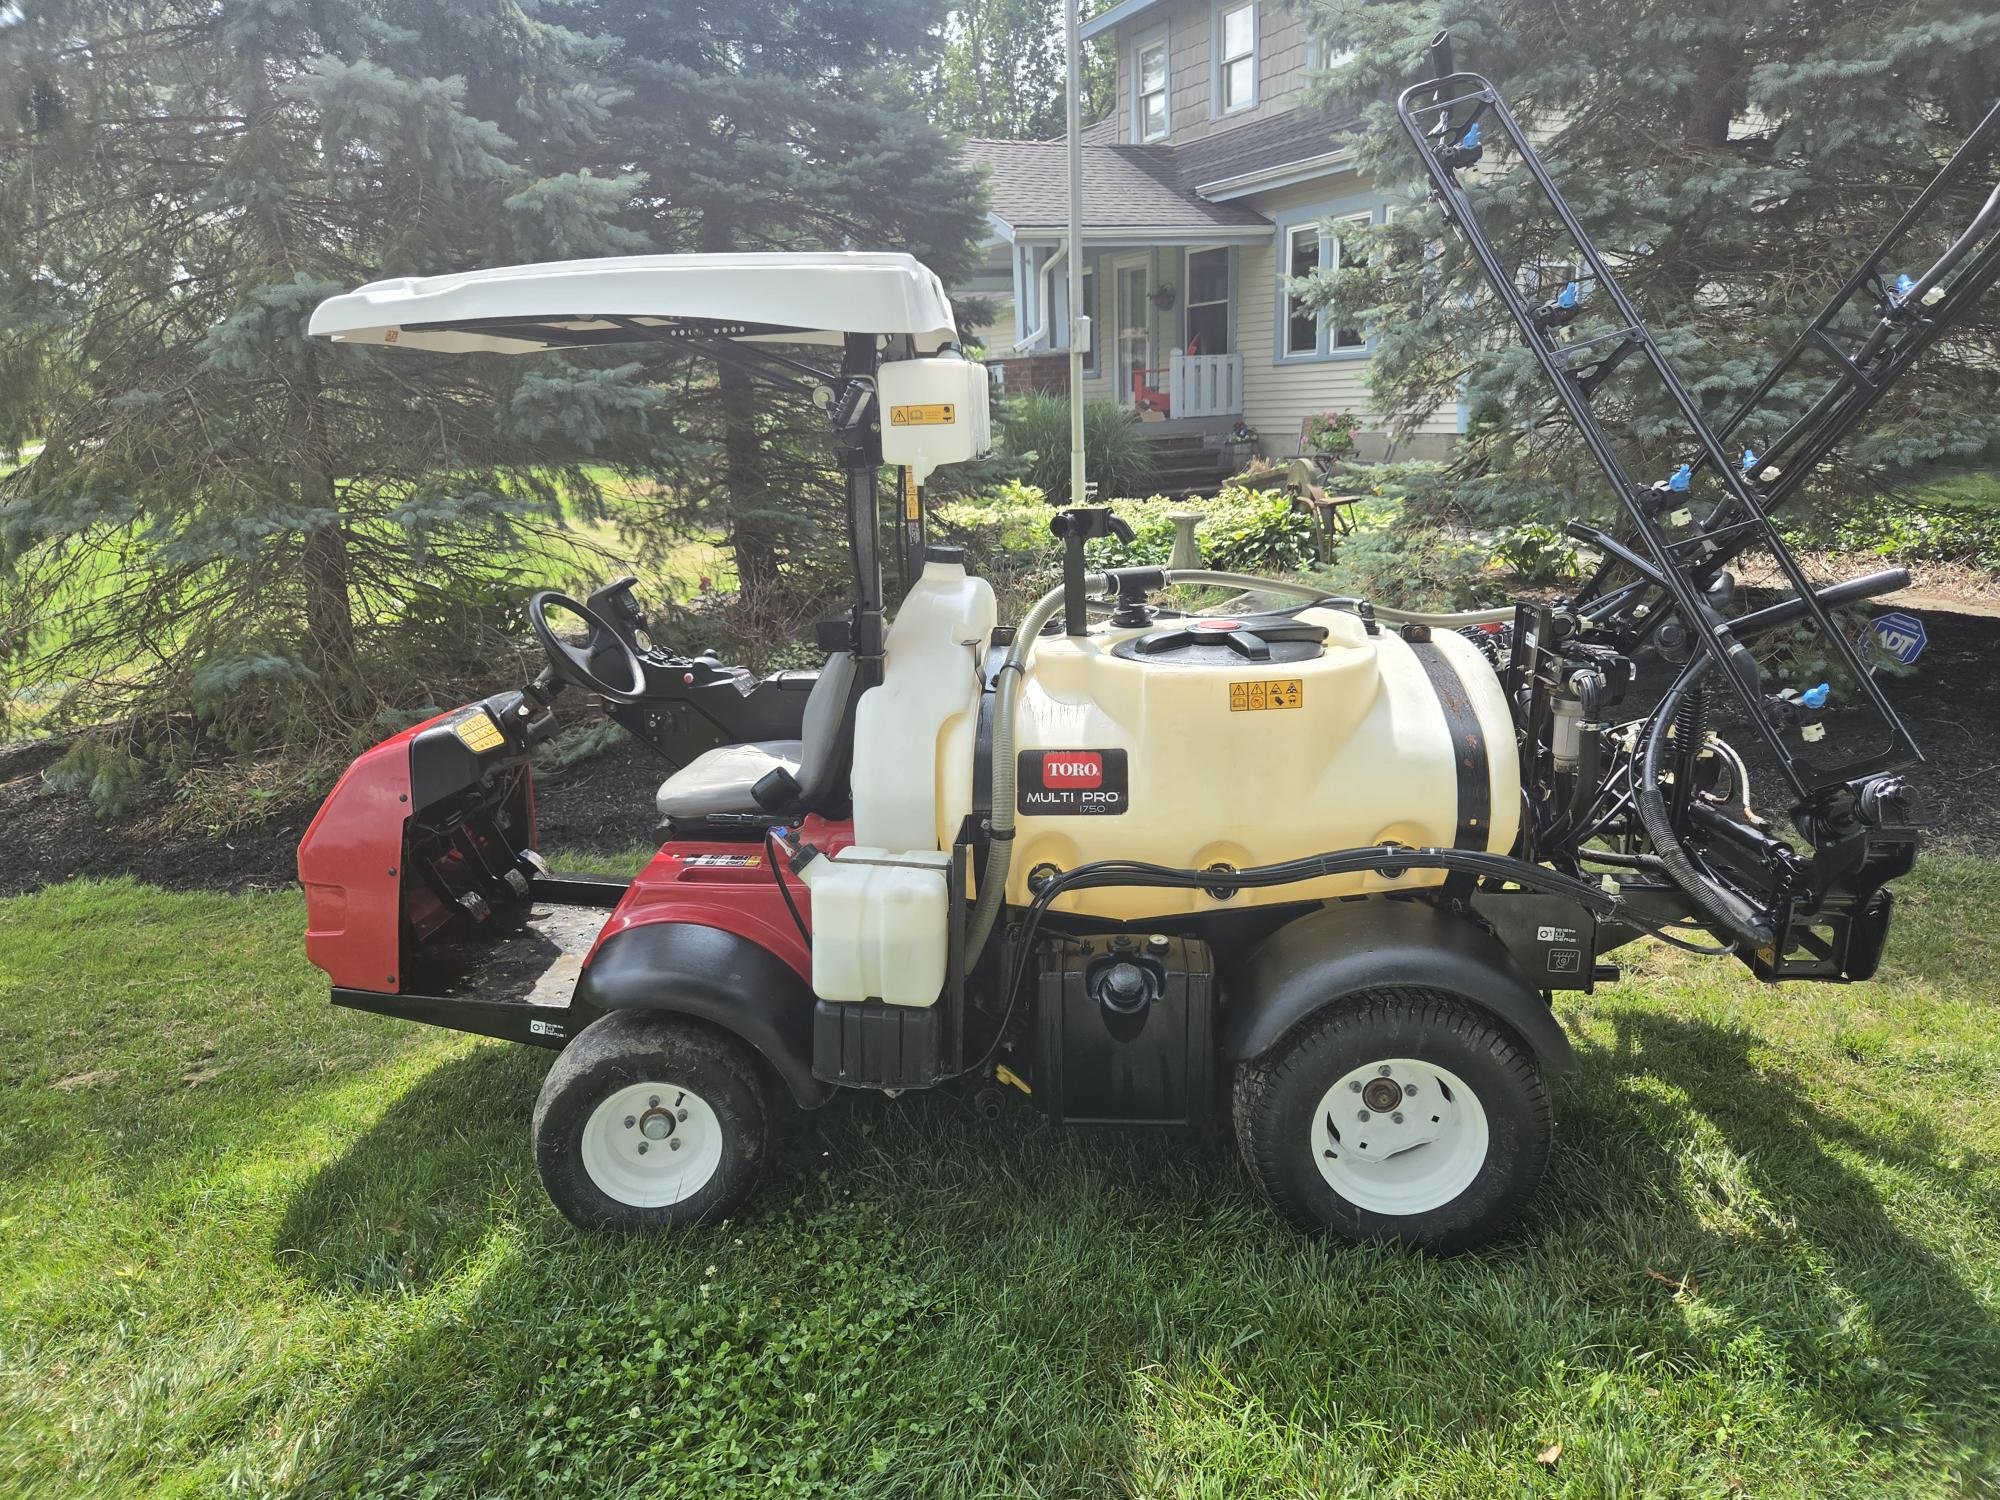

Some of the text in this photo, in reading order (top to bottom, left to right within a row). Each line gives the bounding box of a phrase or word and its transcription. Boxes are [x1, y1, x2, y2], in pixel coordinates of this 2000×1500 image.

[1047, 762, 1098, 776] TORO
[1026, 791, 1119, 803] MULTI PRO
[1079, 805, 1106, 813] 1750
